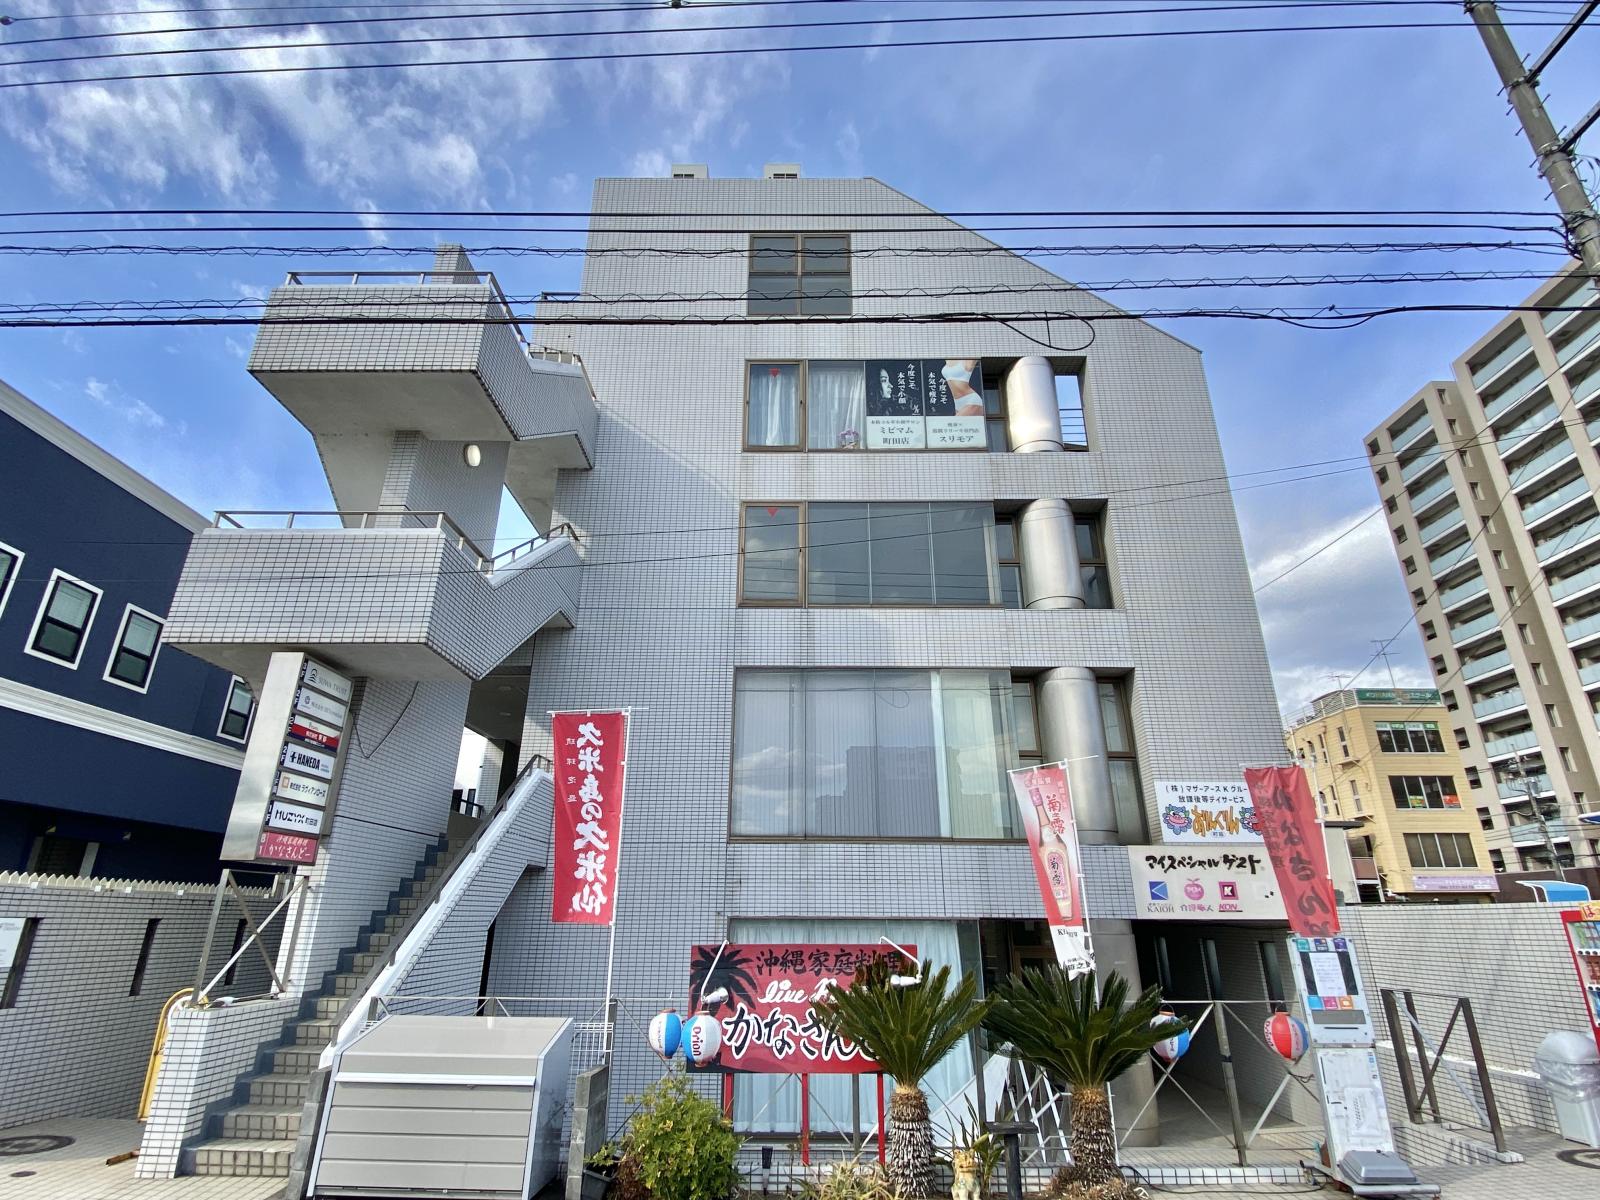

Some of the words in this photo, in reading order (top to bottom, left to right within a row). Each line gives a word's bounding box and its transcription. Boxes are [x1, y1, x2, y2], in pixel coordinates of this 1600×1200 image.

[897, 371, 906, 404] 本気で小顔
[907, 363, 917, 390] 今度こそ
[938, 378, 948, 405] 今度こそ
[939, 435, 974, 443] スリモア
[297, 753, 321, 770] HANEDA
[757, 979, 808, 1003] live
[692, 1026, 703, 1056] Orion
[722, 1002, 880, 1062] かなさん
